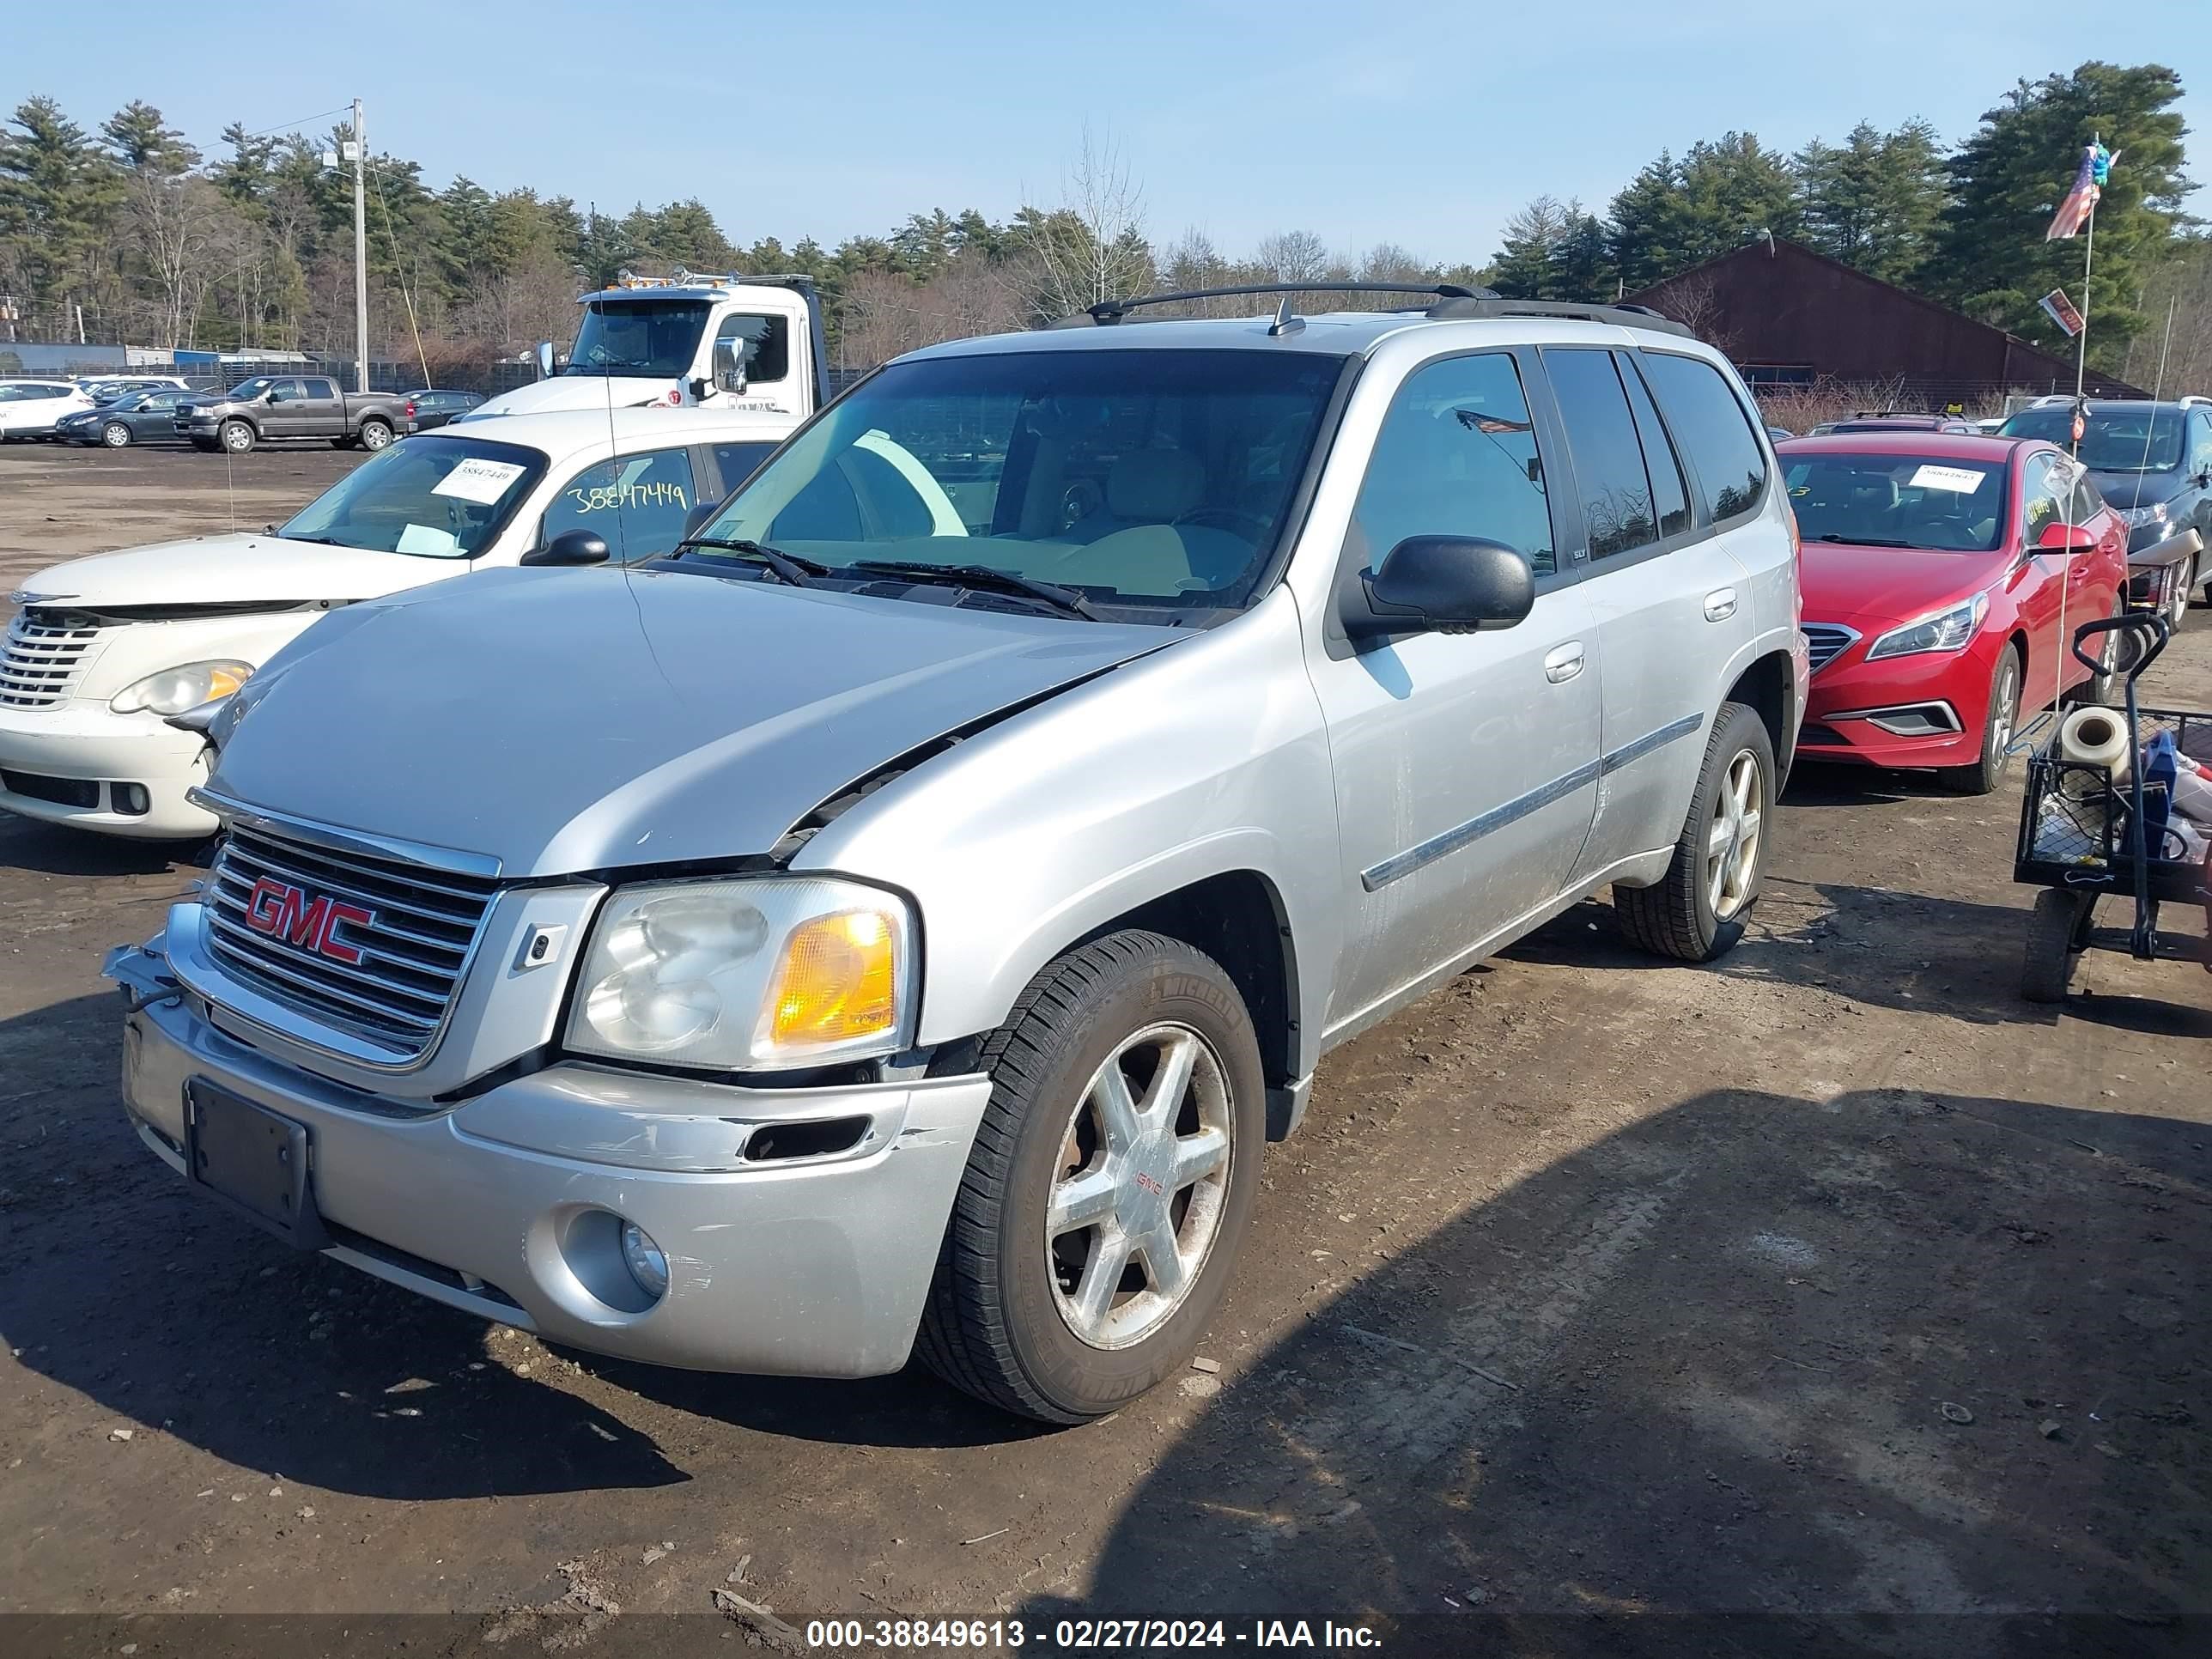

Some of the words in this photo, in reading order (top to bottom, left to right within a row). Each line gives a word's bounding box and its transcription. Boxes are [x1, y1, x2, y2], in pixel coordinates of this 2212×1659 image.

[567, 481, 687, 514] 38847449
[246, 875, 377, 966] GMC
[1161, 977, 1243, 1030] MICHELIN
[1136, 1170, 1164, 1196] GMC
